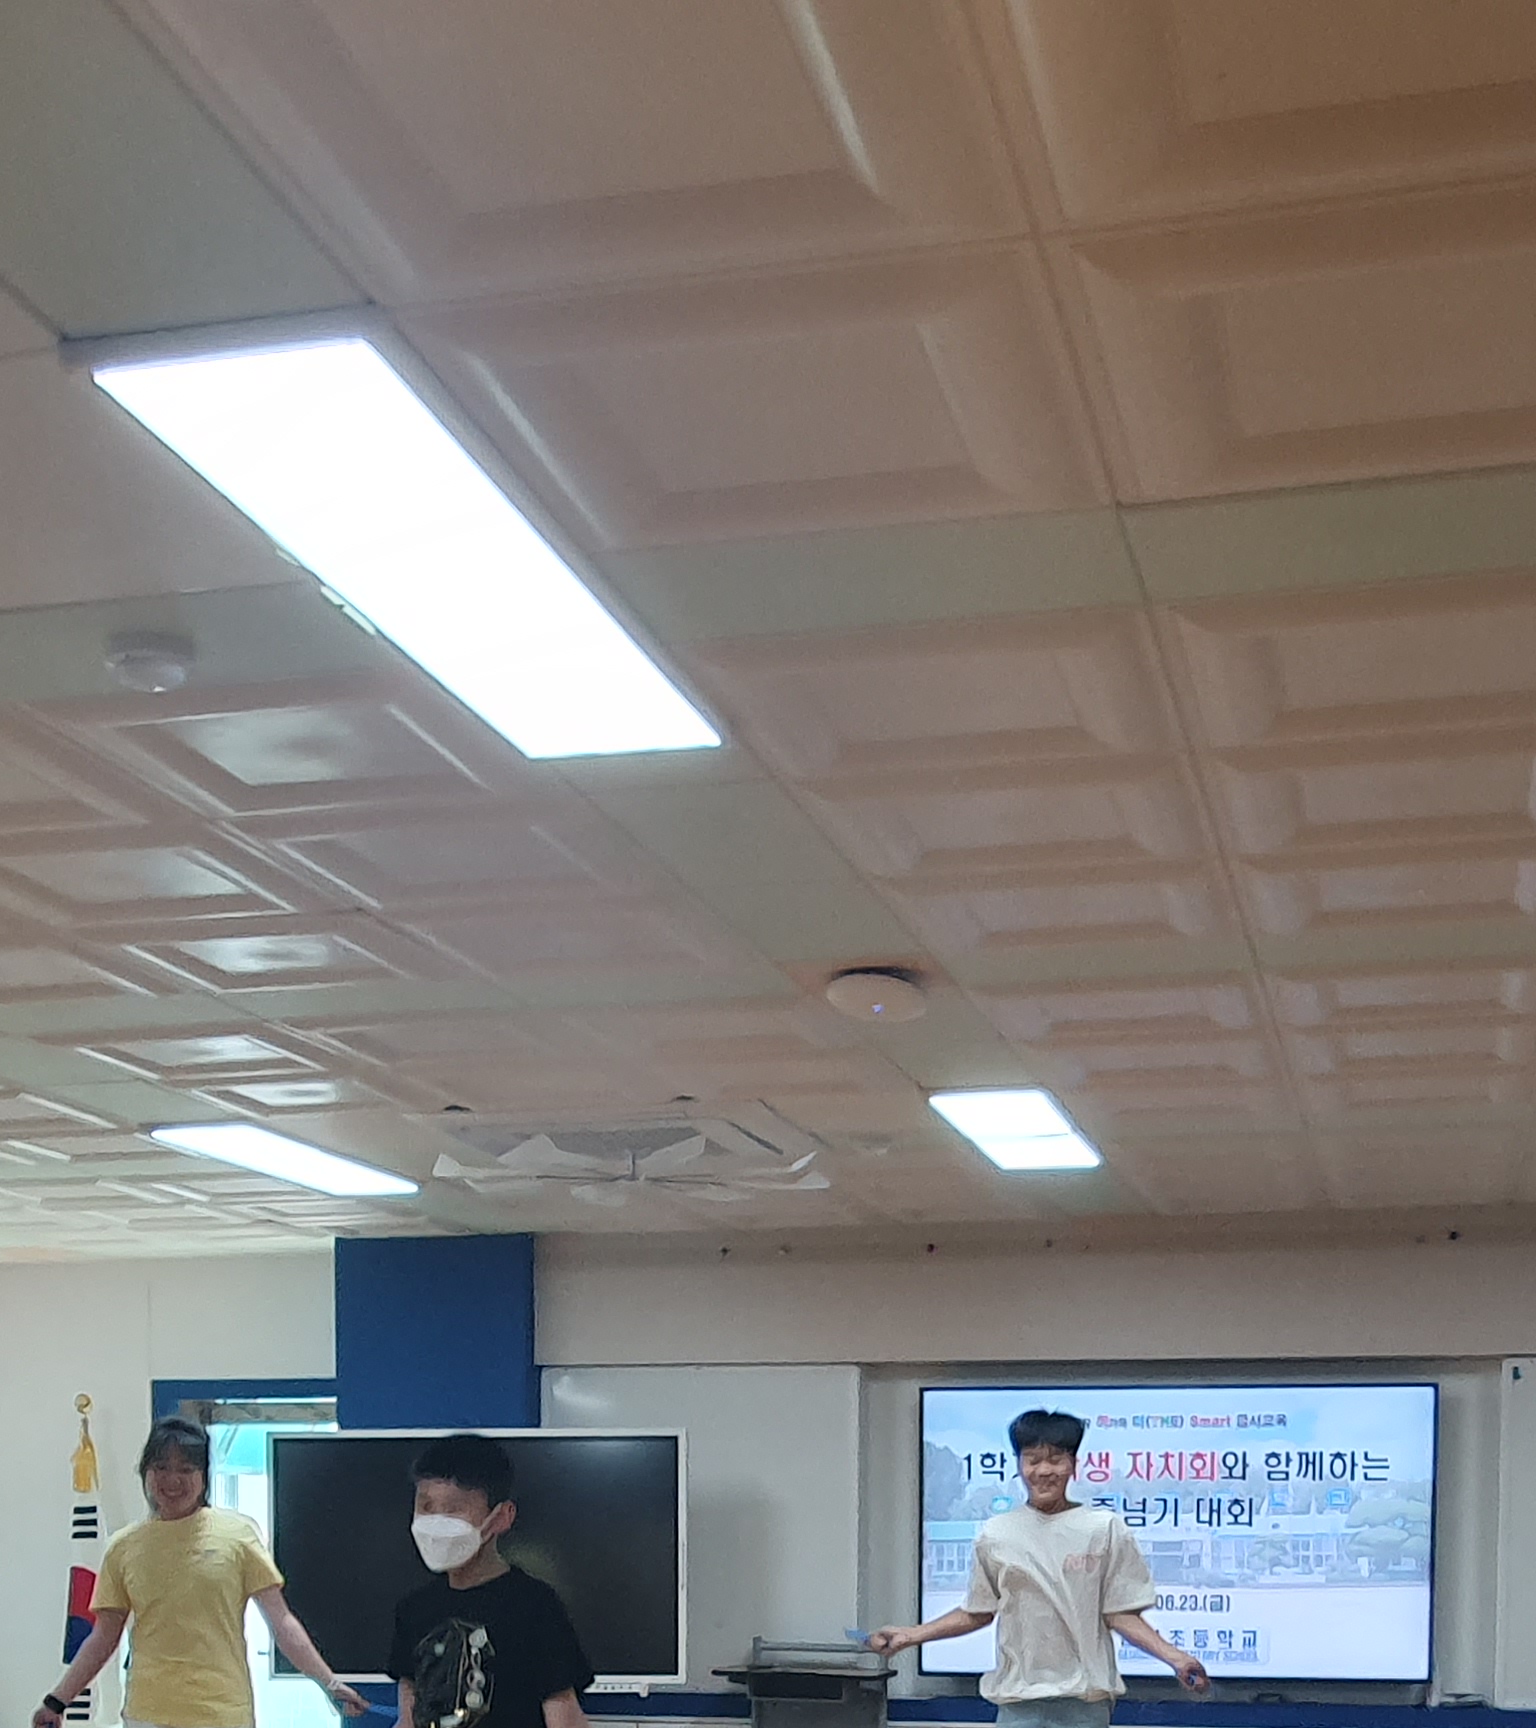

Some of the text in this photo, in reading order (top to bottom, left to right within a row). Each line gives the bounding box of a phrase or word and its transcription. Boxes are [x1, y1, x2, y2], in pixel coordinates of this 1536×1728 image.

[1190, 1415, 1230, 1428] Smart
[963, 1450, 1390, 1482] 1학 생 자치회와 함께하는
[1196, 1497, 1253, 1527] 대회
